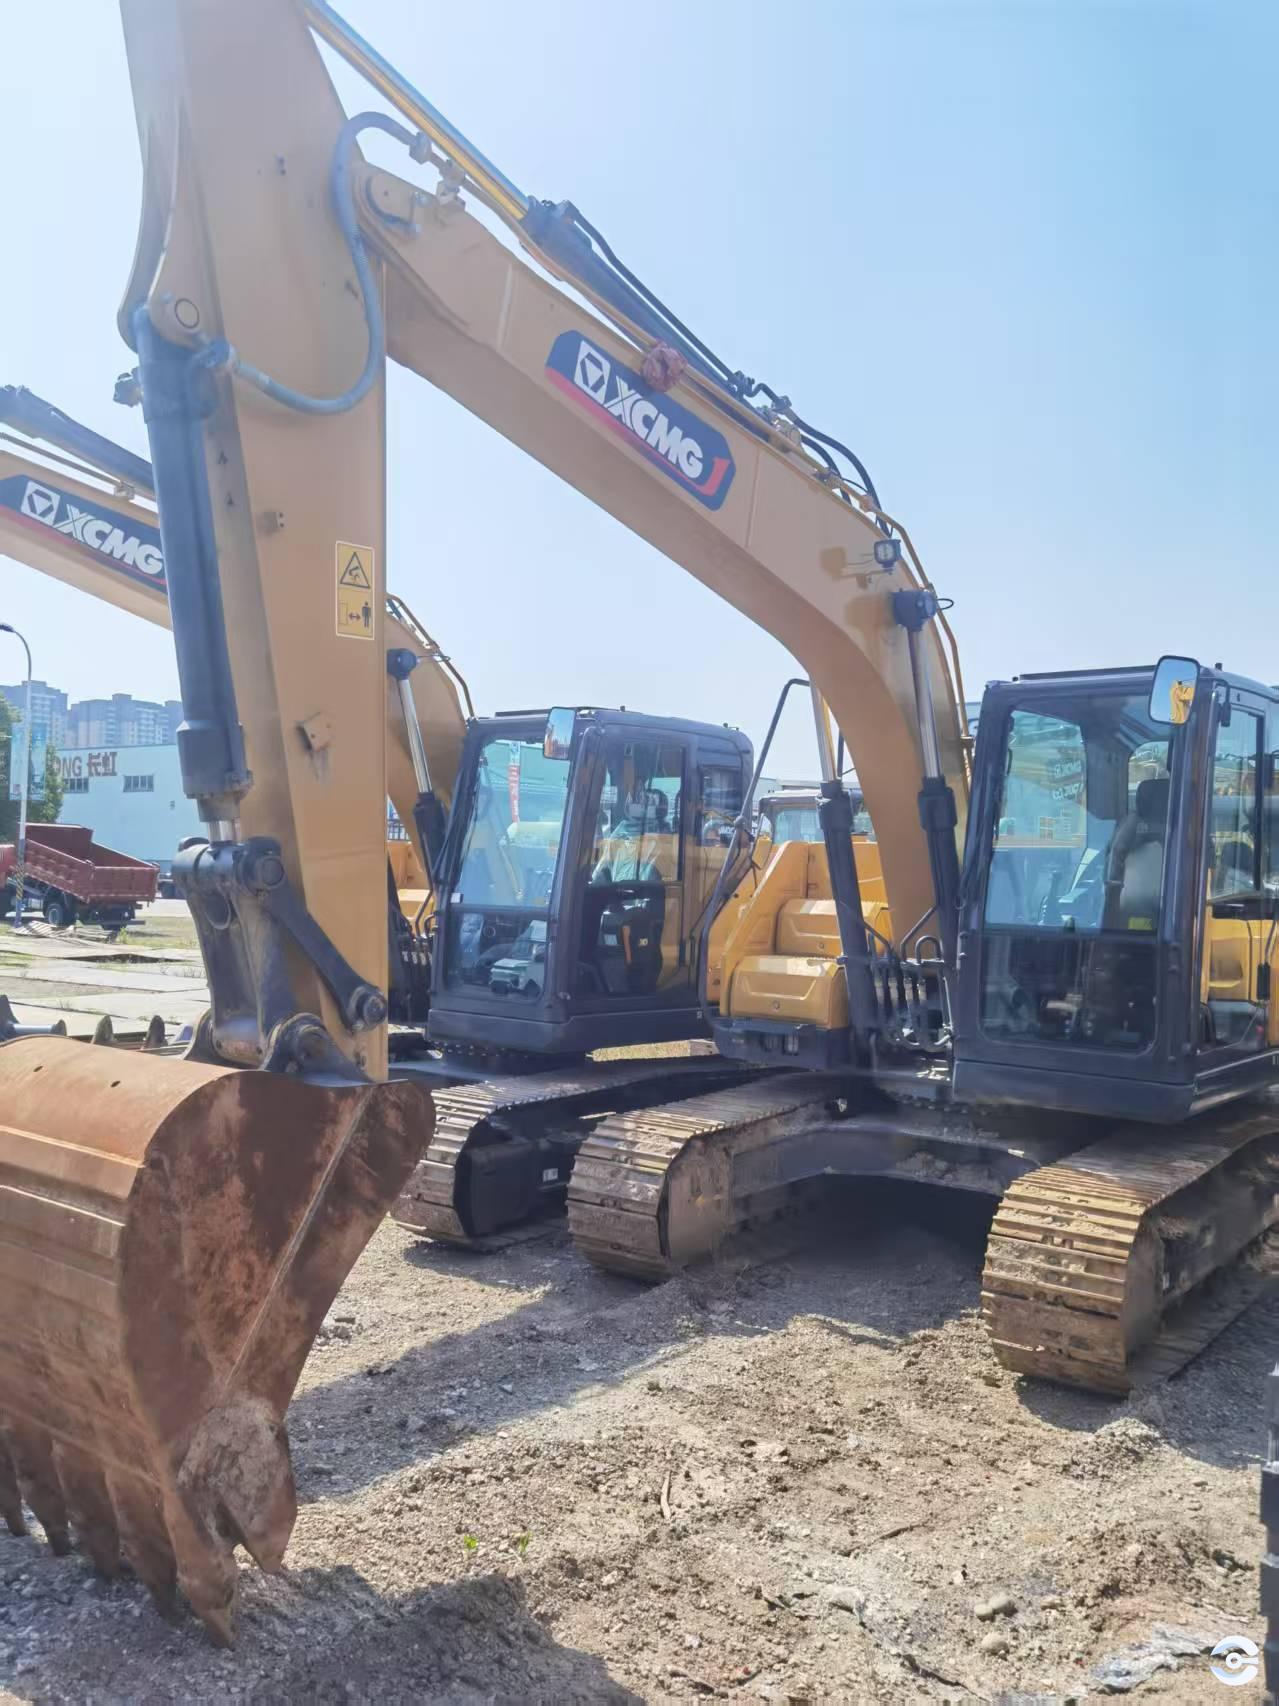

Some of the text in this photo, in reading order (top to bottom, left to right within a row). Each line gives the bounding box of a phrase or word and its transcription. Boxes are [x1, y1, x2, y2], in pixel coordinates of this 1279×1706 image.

[605, 375, 704, 480] XCMG
[54, 503, 164, 575] XCMG
[87, 752, 118, 777] 长虹
